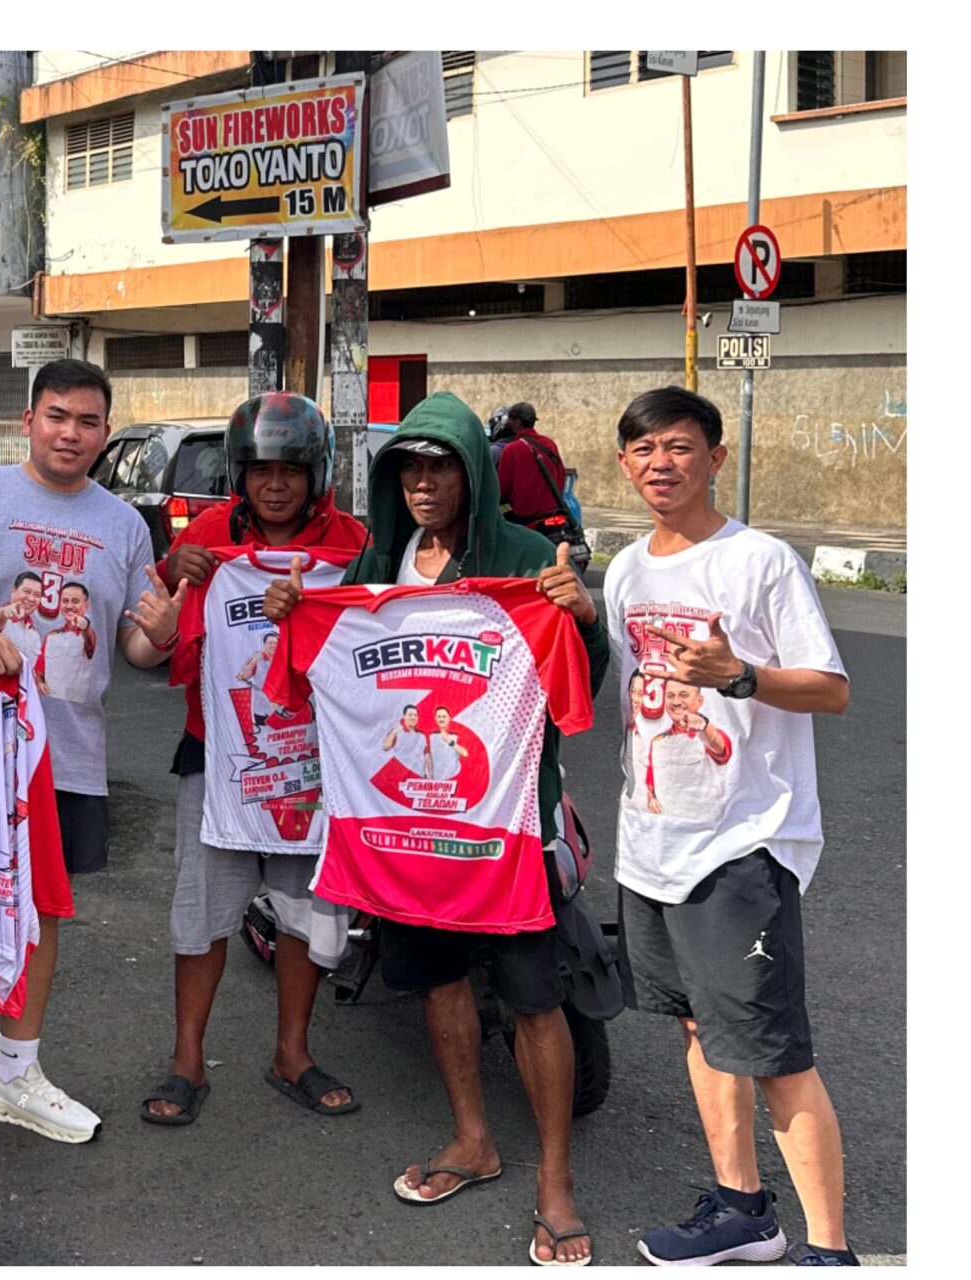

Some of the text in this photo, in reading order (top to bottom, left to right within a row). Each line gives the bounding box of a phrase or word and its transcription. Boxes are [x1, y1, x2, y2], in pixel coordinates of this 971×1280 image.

[178, 96, 347, 154] SUN FIREWORKS
[180, 140, 345, 193] TOKO YANTO
[284, 185, 346, 217] 15 M
[721, 336, 768, 358] POLISI
[23, 533, 90, 574] SK-DT
[39, 572, 63, 617] 3
[358, 638, 497, 673] BERKAT
[401, 838, 429, 851] MAJU
[410, 829, 456, 840] LANJUTKAN
